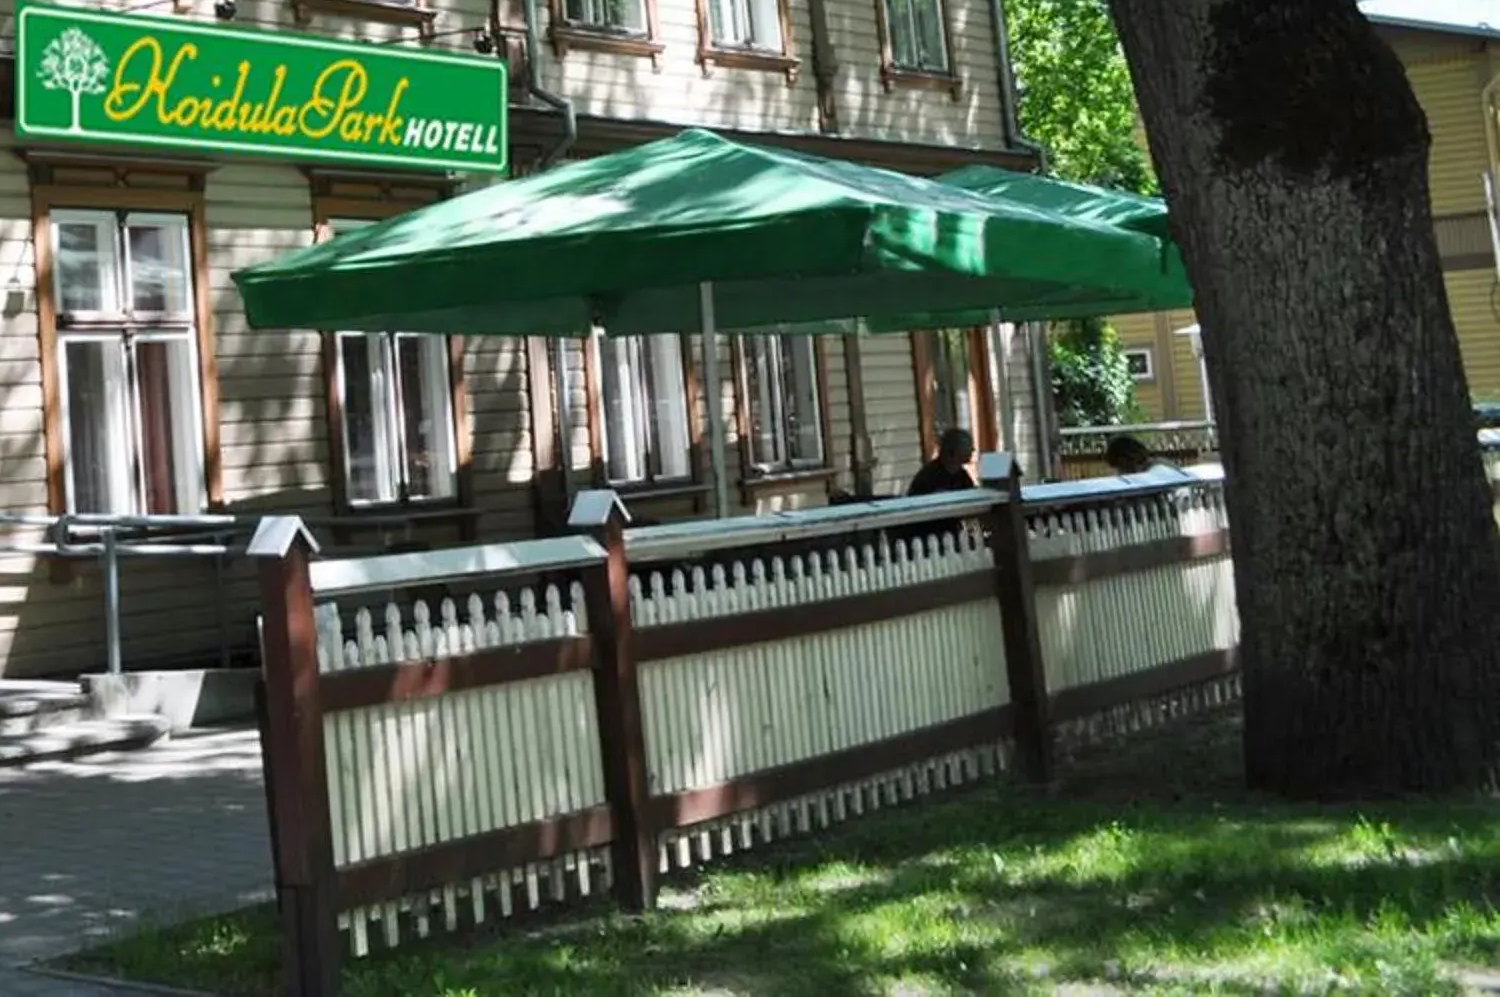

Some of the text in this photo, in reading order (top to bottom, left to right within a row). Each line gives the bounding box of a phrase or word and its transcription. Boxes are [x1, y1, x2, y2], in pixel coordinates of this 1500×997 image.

[104, 36, 498, 154] Koidula Park HOTELL
